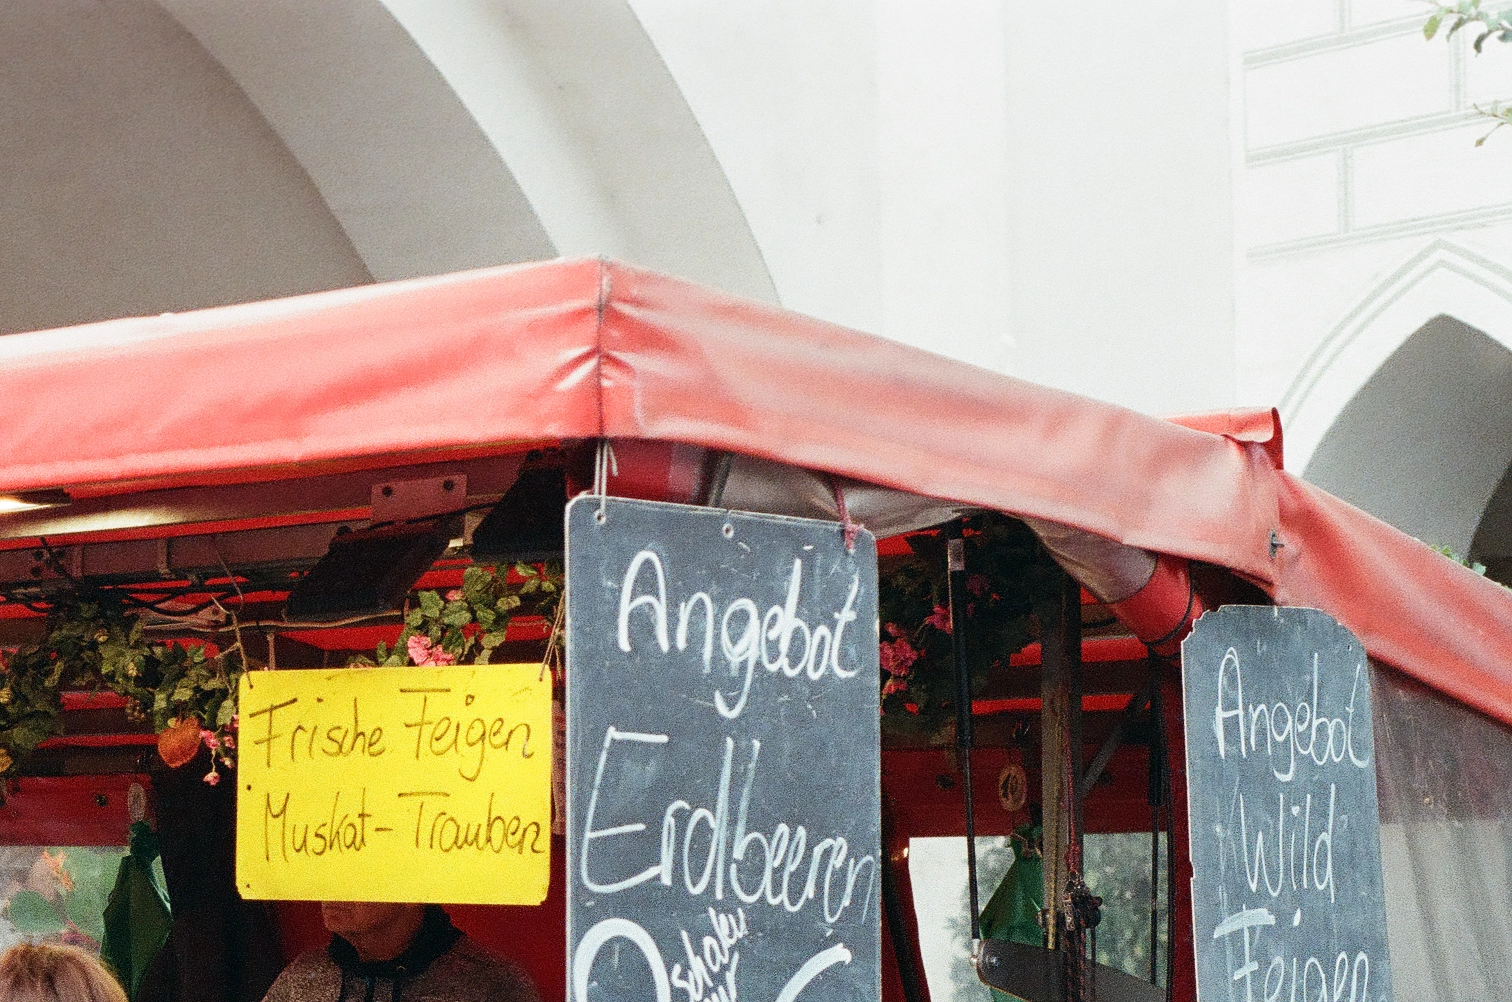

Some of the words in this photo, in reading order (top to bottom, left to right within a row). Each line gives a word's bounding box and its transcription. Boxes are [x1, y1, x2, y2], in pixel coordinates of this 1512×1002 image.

[618, 550, 860, 719] Angebot
[249, 696, 386, 768] Frische
[399, 688, 534, 782] Feigen
[1215, 646, 1369, 782] Angebot
[581, 726, 875, 925] Erdbeeren
[1239, 783, 1336, 904] Wild
